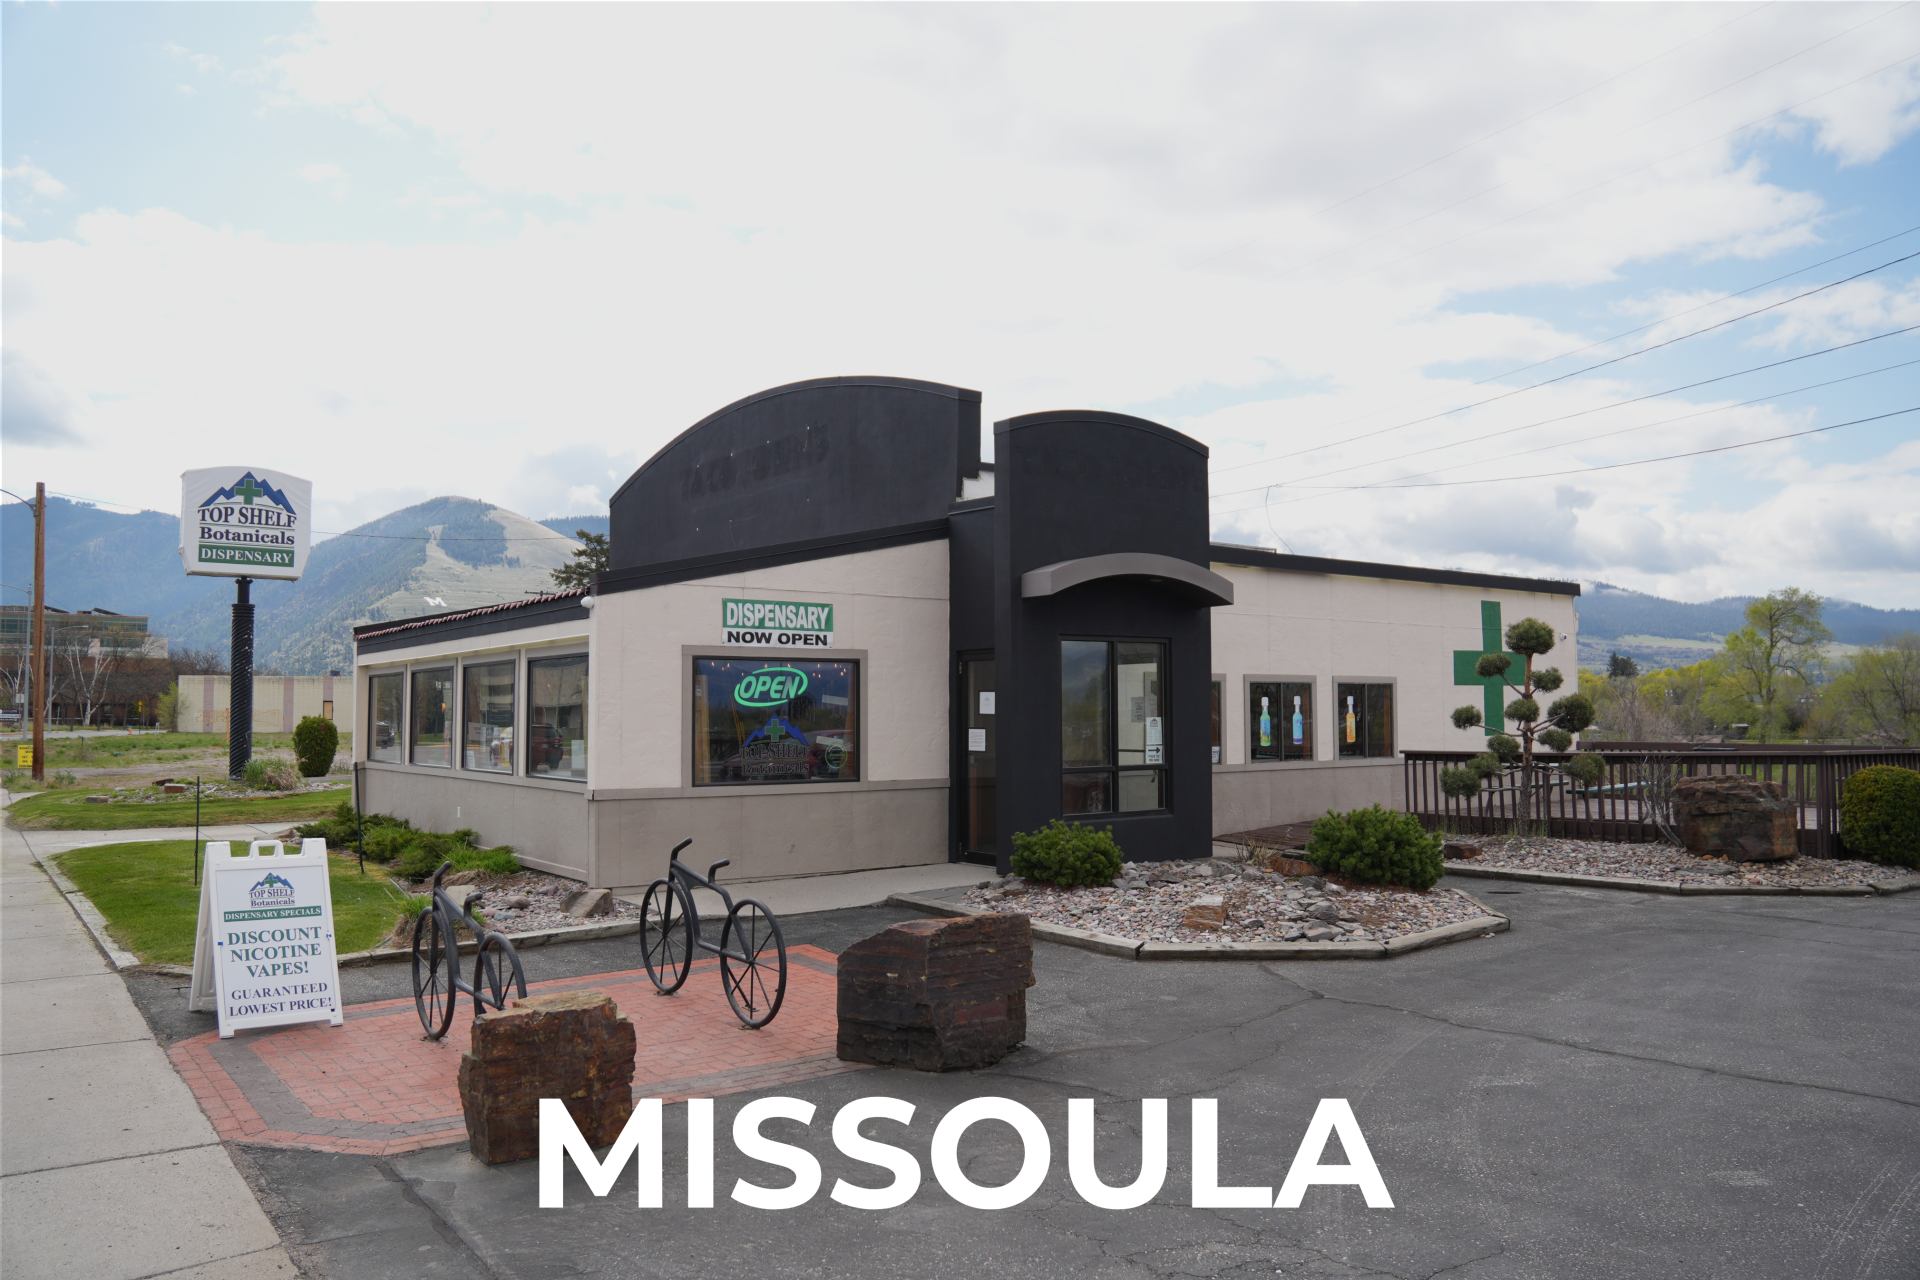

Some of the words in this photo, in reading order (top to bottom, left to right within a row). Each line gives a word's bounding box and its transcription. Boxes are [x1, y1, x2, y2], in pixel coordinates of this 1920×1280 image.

[197, 506, 235, 523] TOP
[238, 506, 297, 527] SHELF
[199, 526, 295, 545] Botanicals
[200, 548, 292, 563] DISPENSARY
[726, 602, 829, 630] DISPENSARY
[727, 631, 773, 644] NOW
[777, 633, 828, 646] OPEN
[739, 675, 800, 699] OPEN
[740, 744, 766, 759] TOP
[767, 742, 810, 758] SHELF
[741, 760, 810, 775] Botanicals
[249, 889, 266, 898] TOP
[267, 888, 295, 897] SHELF
[250, 898, 295, 906] Botanicals
[225, 910, 279, 921] DISPENSARY
[280, 907, 321, 917] SPECIALS
[227, 926, 322, 946] DISCOUNT
[230, 943, 322, 963] NICOTINE
[246, 961, 309, 978] VAPES!
[231, 982, 328, 1000] GUARANTEED
[229, 1002, 286, 1016] LOWEST
[289, 997, 332, 1010] PRICE!
